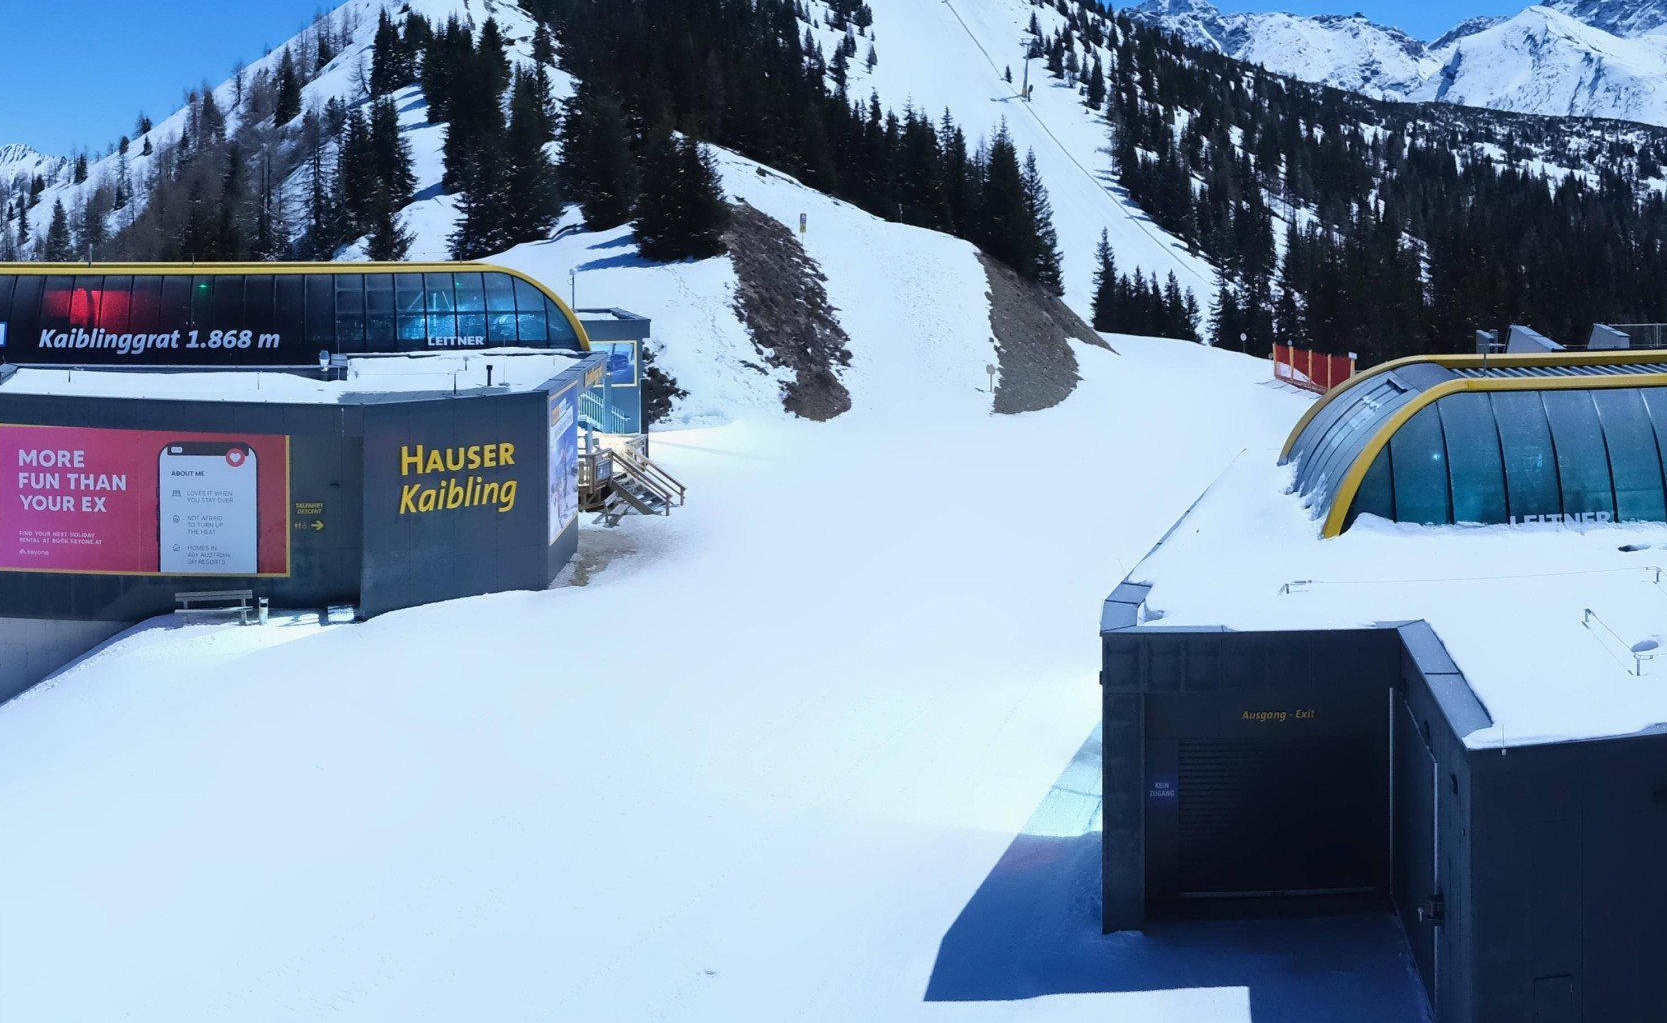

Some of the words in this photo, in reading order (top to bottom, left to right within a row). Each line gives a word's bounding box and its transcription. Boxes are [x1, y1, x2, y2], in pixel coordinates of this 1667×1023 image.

[38, 328, 180, 354] Kaiblinggrat
[185, 329, 252, 349] 1.868
[258, 333, 280, 348] m
[427, 336, 485, 346] LEITNER
[18, 449, 85, 468] MORE
[401, 442, 515, 476] HAUSER
[18, 472, 59, 489] FUN
[66, 474, 126, 491] THAN
[20, 495, 75, 511] YOUR
[81, 496, 107, 512] EX
[399, 476, 517, 514] Kaibling
[1241, 710, 1287, 722] Ausgang
[1295, 708, 1316, 720] Exit
[1150, 789, 1175, 797] ZUGANG
